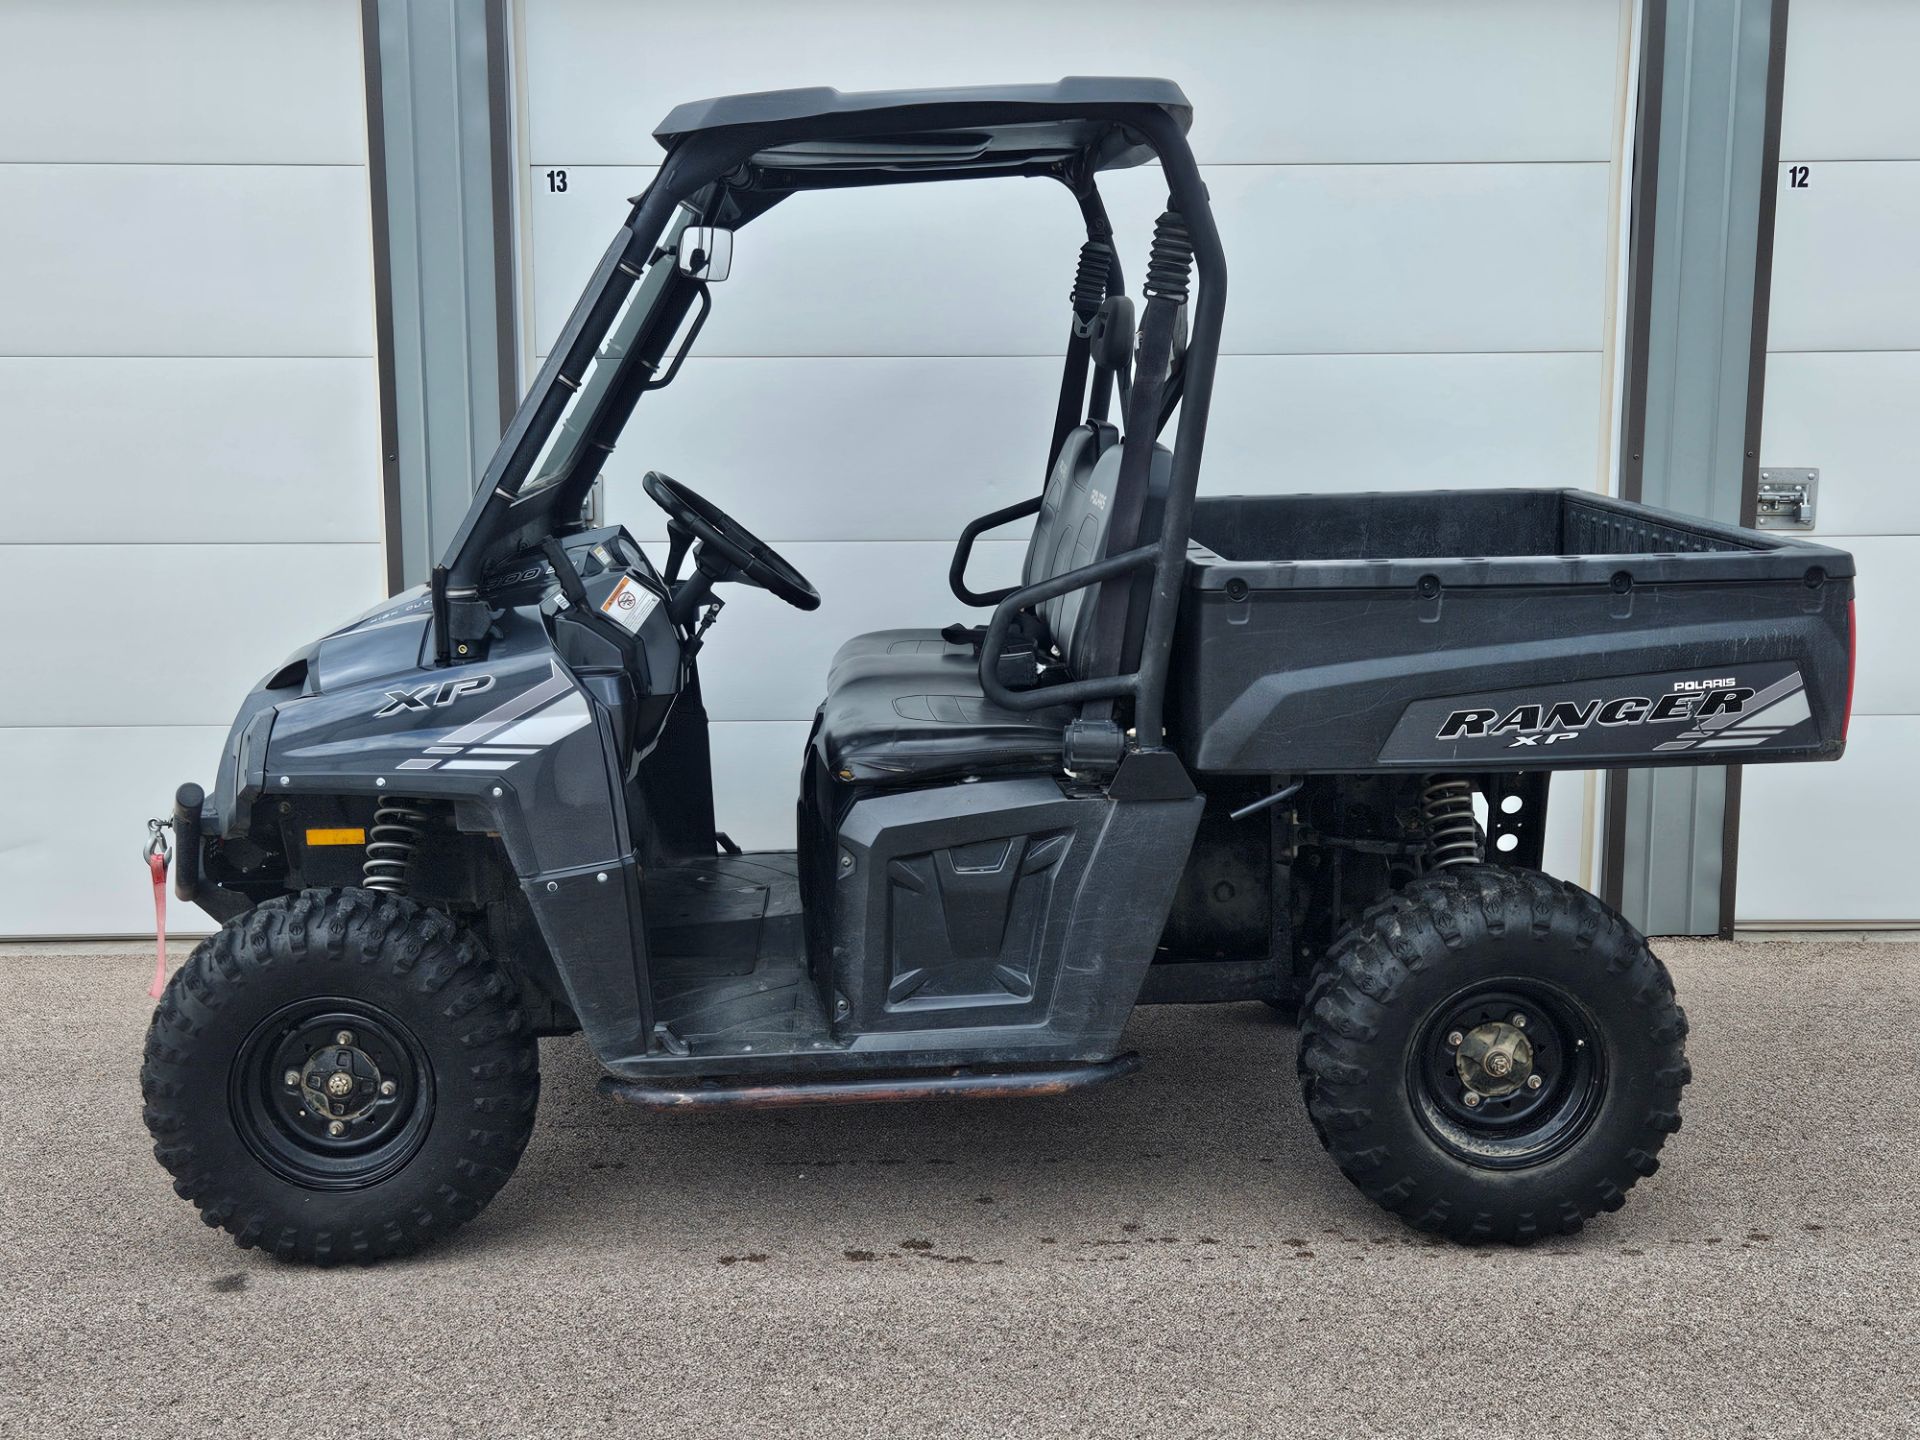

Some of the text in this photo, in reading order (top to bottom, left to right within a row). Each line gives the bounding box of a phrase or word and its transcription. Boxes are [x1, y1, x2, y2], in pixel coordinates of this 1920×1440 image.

[547, 170, 568, 193] 13
[1789, 166, 1810, 188] 12
[1673, 677, 1736, 692] POLARIS
[372, 675, 496, 718] XP
[1435, 687, 1756, 740] RANGER
[1508, 732, 1579, 748] XP
